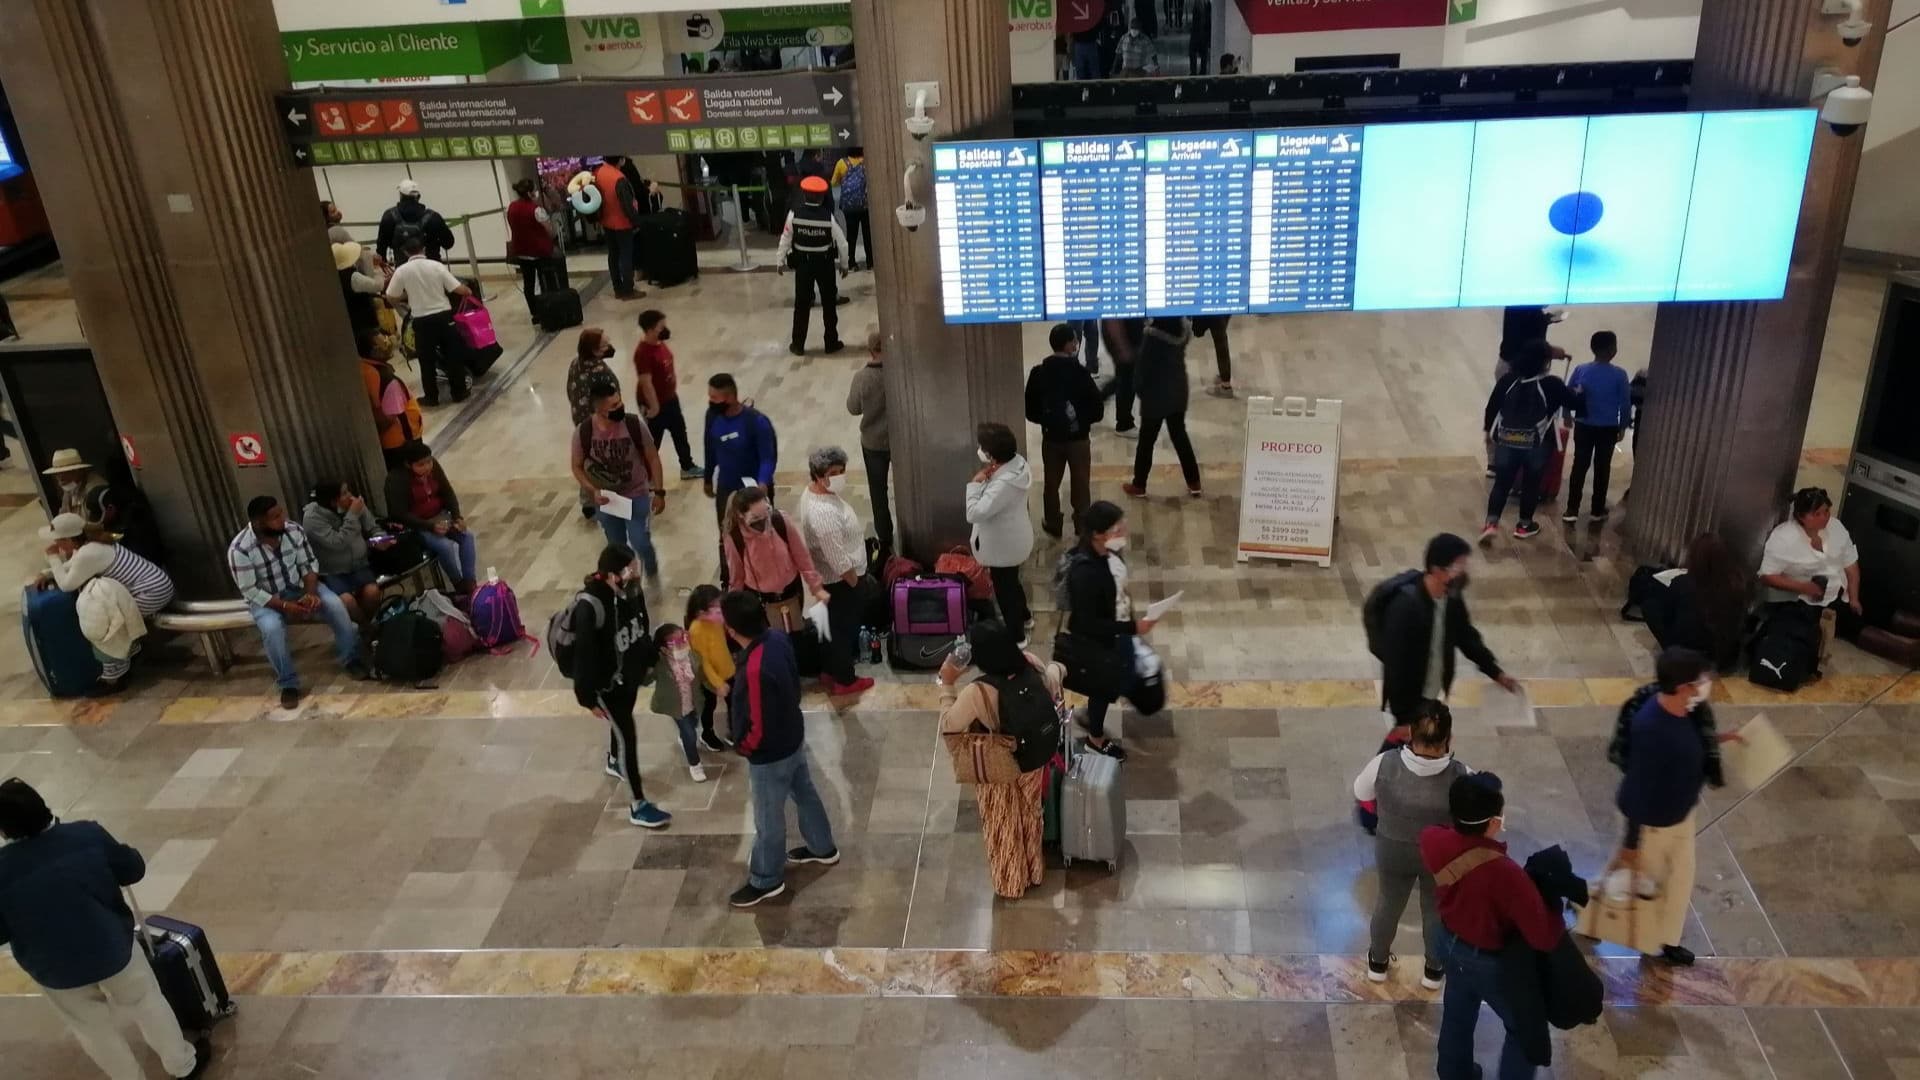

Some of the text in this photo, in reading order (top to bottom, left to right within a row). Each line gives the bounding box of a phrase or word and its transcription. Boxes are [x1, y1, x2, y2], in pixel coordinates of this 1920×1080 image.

[1014, 20, 1052, 31] aerobus
[606, 40, 643, 50] aerobus
[742, 35, 764, 46] Viva
[766, 33, 805, 47] Express
[293, 44, 303, 61] y
[307, 38, 376, 56] Servicio
[380, 33, 395, 52] al
[398, 32, 458, 51] Cliente
[703, 87, 773, 99] Salida nacional
[419, 98, 507, 110] Salida internacional
[704, 96, 782, 109] Llegada nacional
[421, 107, 517, 120] Llegada internacional
[706, 109, 742, 118] Domestic
[744, 107, 785, 118] departures
[791, 106, 819, 115] arrivals
[424, 120, 470, 129] International
[471, 118, 511, 128] departures
[517, 117, 544, 126] arrivals
[1171, 139, 1218, 151] Llegadas
[1279, 135, 1327, 147] Llegadas
[1066, 141, 1110, 155] Salidas
[1279, 146, 1311, 156] Arrivals
[959, 148, 1002, 162] Salidas
[1066, 153, 1110, 163] Departures
[1171, 150, 1202, 160] Arrivals
[959, 159, 1002, 169] Departures
[1261, 441, 1322, 454] PROFECO
